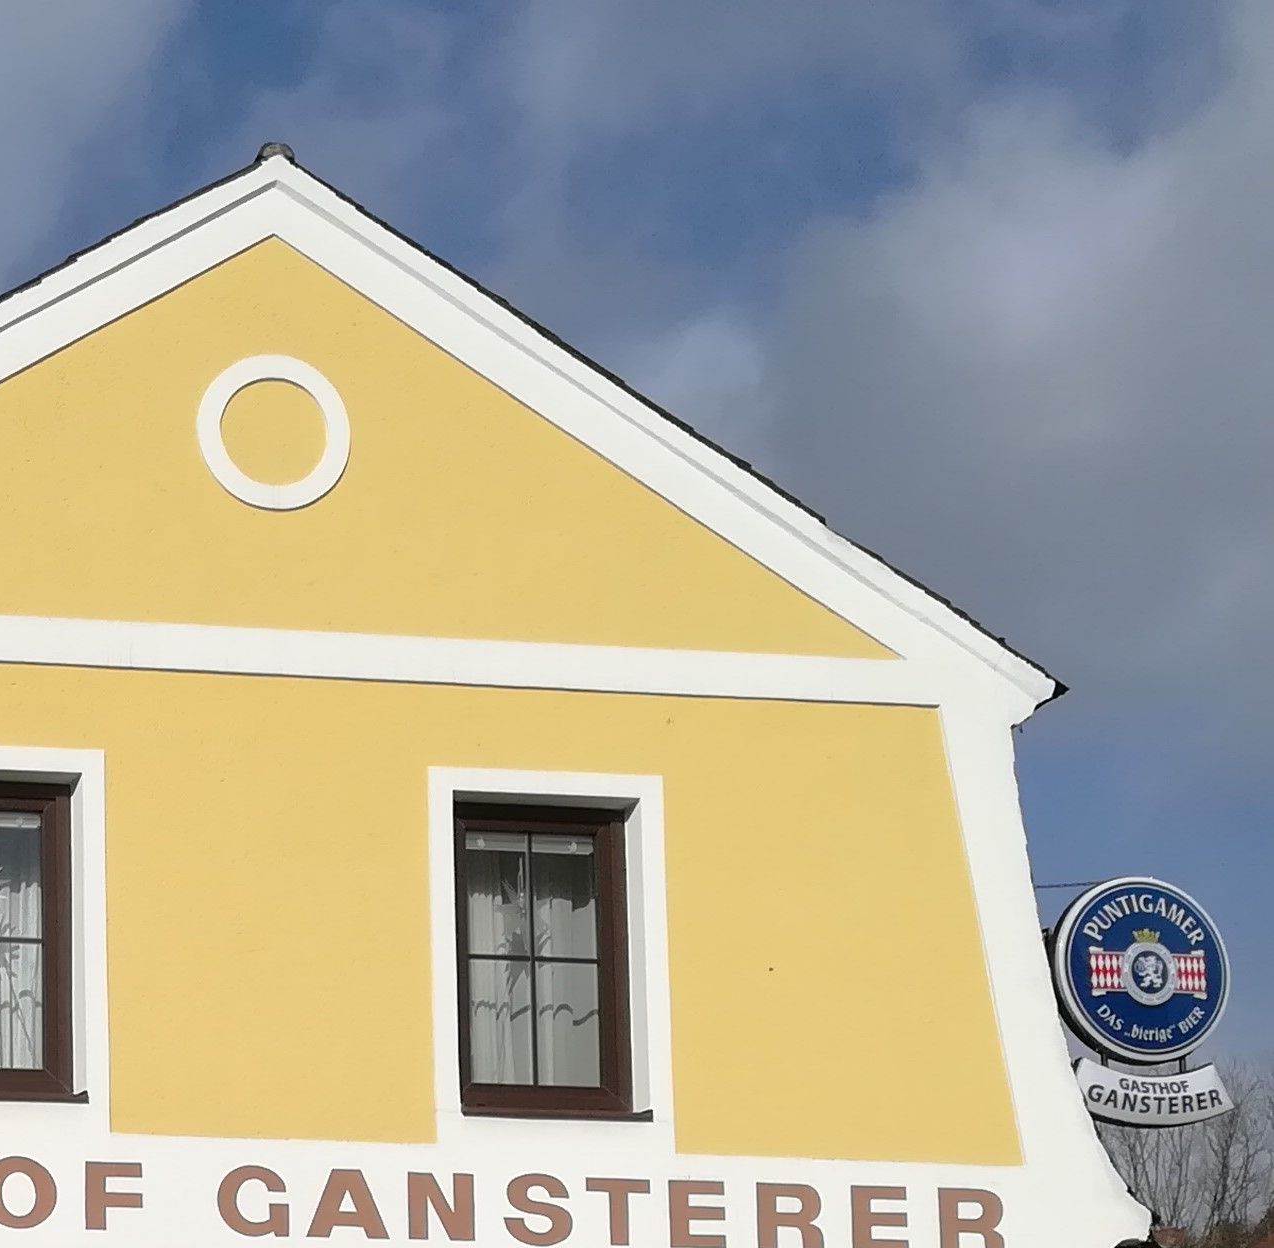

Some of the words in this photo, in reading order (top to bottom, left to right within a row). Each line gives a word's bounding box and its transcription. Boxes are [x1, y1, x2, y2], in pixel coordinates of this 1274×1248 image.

[1083, 894, 1205, 946] PUNTIGAMER
[1096, 1004, 1125, 1031] DAS
[1177, 1006, 1206, 1035] BIER
[1087, 1084, 1223, 1115] GANSTERER
[1119, 1077, 1190, 1095] GASTHOF
